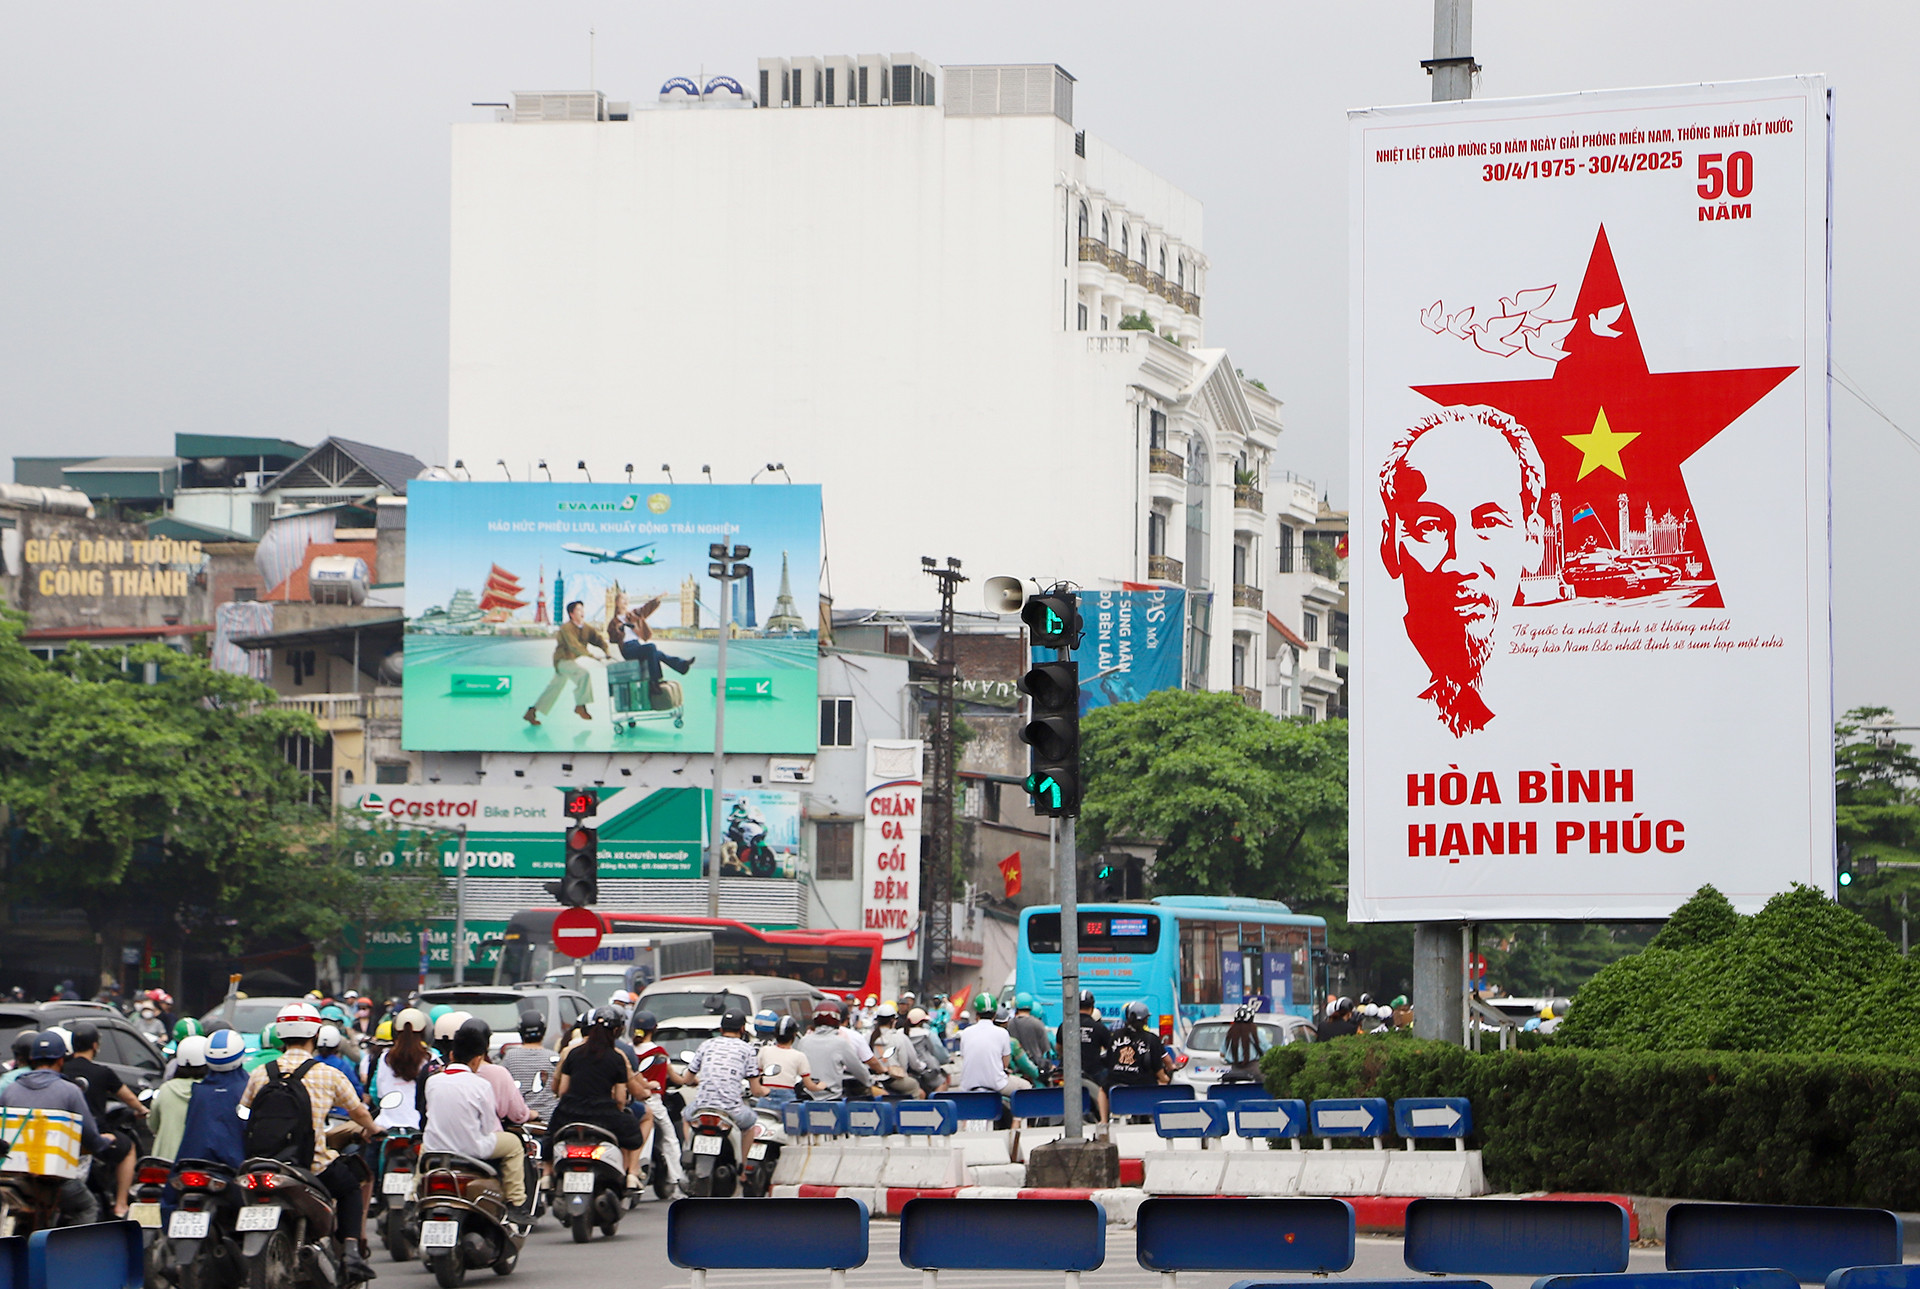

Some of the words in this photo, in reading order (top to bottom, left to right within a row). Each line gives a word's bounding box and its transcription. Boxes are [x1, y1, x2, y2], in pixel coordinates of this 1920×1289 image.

[1376, 146, 1404, 164] NHIỆT
[1407, 145, 1426, 163] LIỆT
[1429, 143, 1455, 159] CHÀO
[1458, 140, 1487, 157] MỪNG
[1490, 142, 1502, 155] 50
[1505, 138, 1527, 153] NĂM
[1530, 136, 1557, 152] NGÀY
[1560, 130, 1580, 149] GIẢI
[1582, 131, 1616, 148] PHÓNG
[1619, 126, 1645, 145] MIỀN
[1648, 129, 1675, 143] NAM,
[1677, 122, 1711, 141] THỐNG
[1714, 119, 1740, 139] NHẤT
[1743, 117, 1762, 136] ĐẤT
[1765, 116, 1794, 135] NƯỚC
[1482, 158, 1576, 182] 30/4/1975
[1588, 150, 1683, 174] 30/4/2025
[1696, 151, 1754, 200] 50
[1698, 202, 1752, 222] NĂM
[538, 519, 571, 533] PHIÊU
[638, 520, 669, 535] ĐỘNG
[25, 534, 73, 564] GIẤY
[79, 535, 124, 564] DÁN
[131, 534, 202, 564] TƯỜNG
[39, 564, 104, 597] CÔNG
[110, 565, 188, 597] THÀNH
[1098, 612, 1114, 640] BỀN
[1119, 600, 1132, 637] SUNG
[1530, 624, 1559, 640] quốc
[1562, 623, 1575, 635] ta
[1578, 621, 1608, 635] nhất
[1611, 620, 1641, 636] định
[1644, 622, 1658, 634] sẽ
[1660, 618, 1697, 636] thống
[1700, 618, 1731, 632] nhất
[1098, 643, 1114, 671] LÂU
[1119, 641, 1134, 673] MÃN
[1562, 640, 1590, 653] Nam
[1615, 638, 1643, 651] nhất
[1644, 637, 1670, 652] định
[1688, 640, 1711, 650] sum
[1737, 636, 1759, 650] một
[1761, 634, 1785, 648] nhà
[1407, 763, 1502, 807] HÒA
[1518, 762, 1634, 804] BÌNH
[389, 798, 478, 818] Castrol
[484, 806, 510, 818] Bike
[513, 806, 547, 818] Point
[870, 793, 916, 817] CHĂN
[881, 821, 904, 839] GA
[1408, 821, 1538, 864] HẠNH
[1555, 812, 1685, 854] PHÚC
[877, 845, 906, 871] GỐI
[874, 876, 908, 904] ĐỆM
